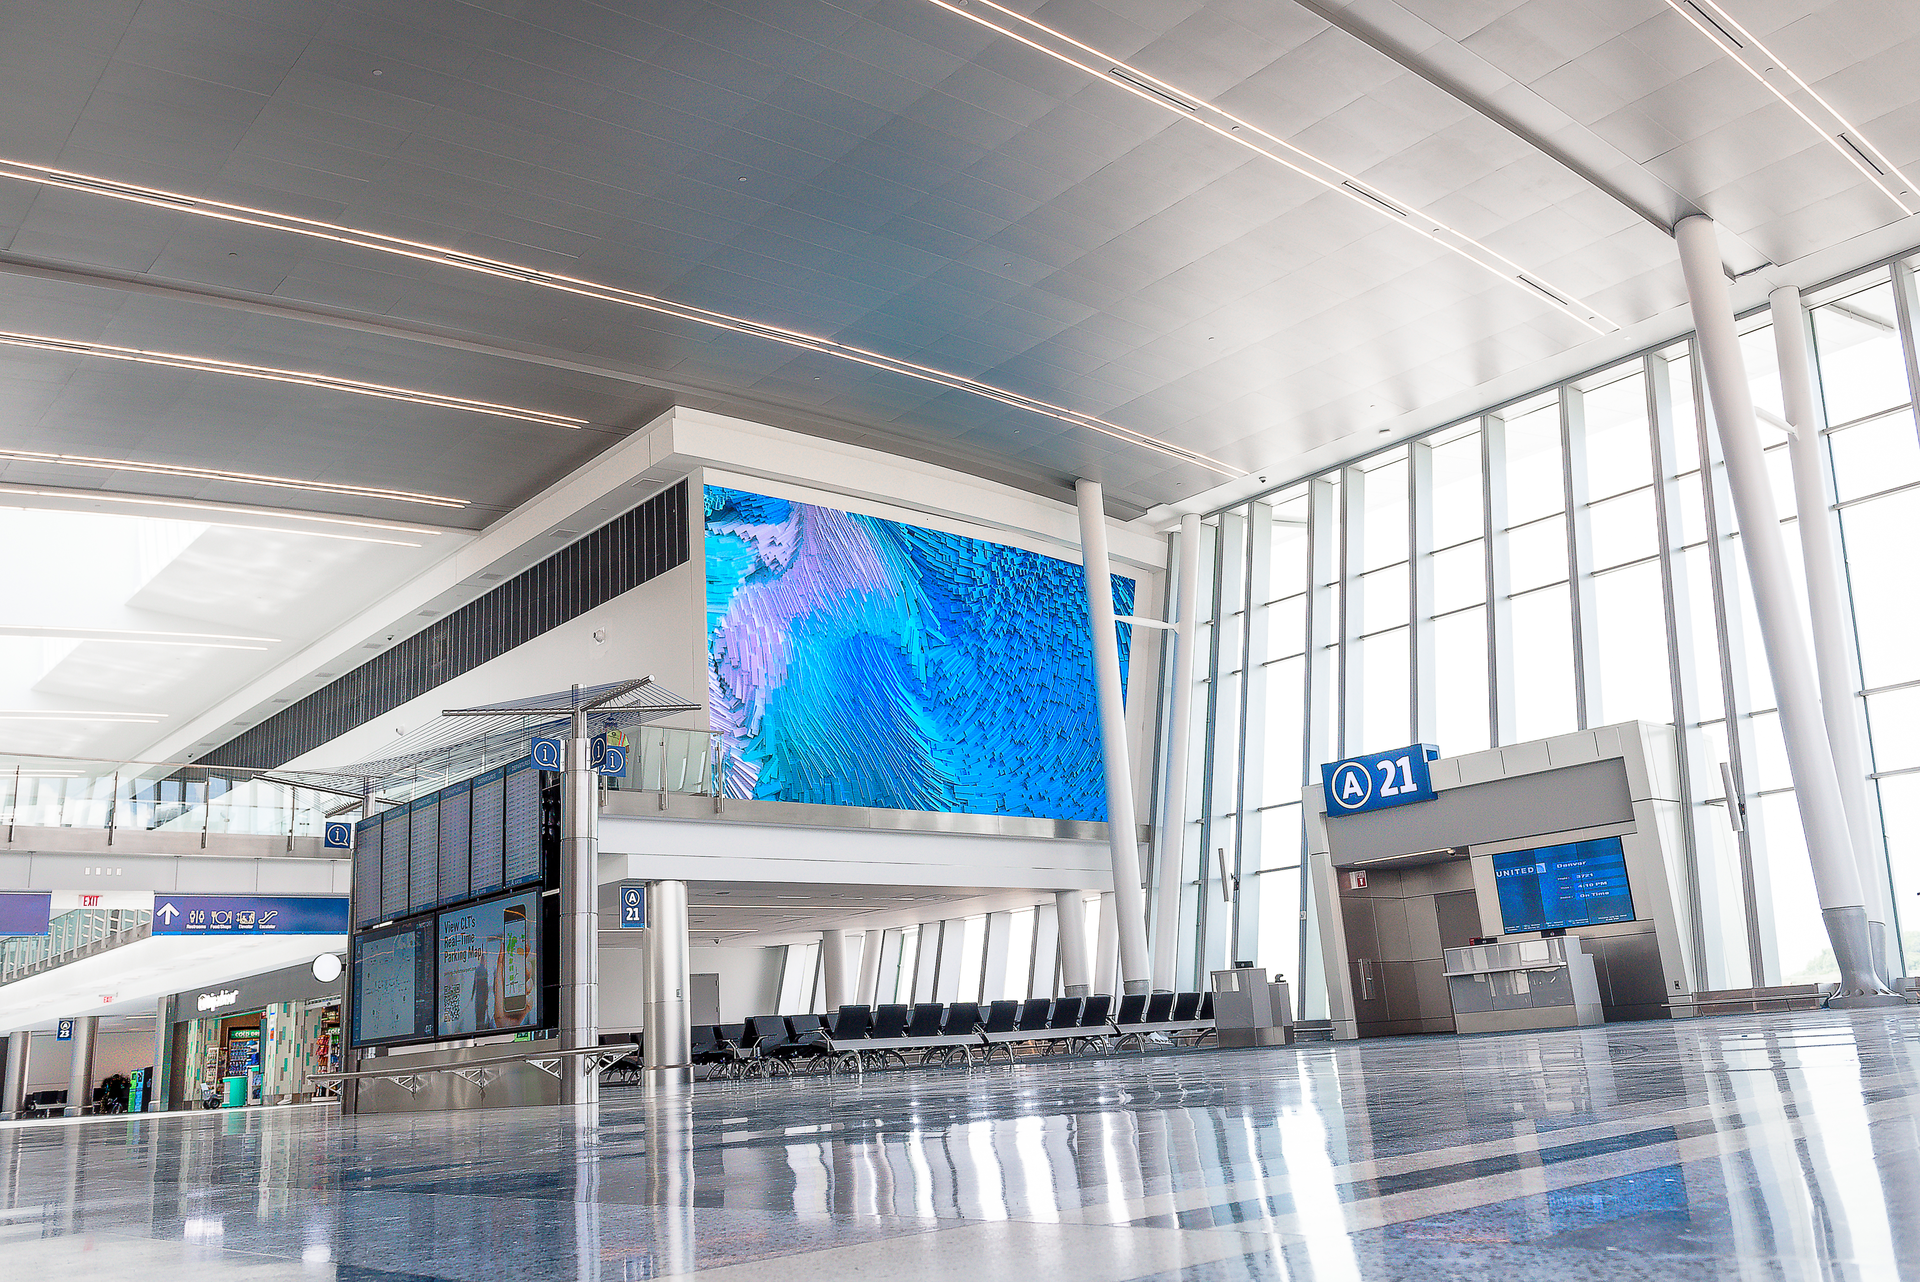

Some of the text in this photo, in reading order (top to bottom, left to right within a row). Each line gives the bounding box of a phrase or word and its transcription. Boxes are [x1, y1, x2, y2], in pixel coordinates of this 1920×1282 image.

[1342, 755, 1418, 800] A 21
[1556, 861, 1587, 869] Denver
[1496, 866, 1534, 878] UNITED
[83, 895, 100, 907] EXIT
[628, 892, 637, 903] A
[626, 907, 640, 921] 21
[444, 914, 476, 934] View CLT's
[444, 932, 475, 949] Real-Time
[444, 943, 484, 963] Parking Map!
[59, 1030, 70, 1038] 23
